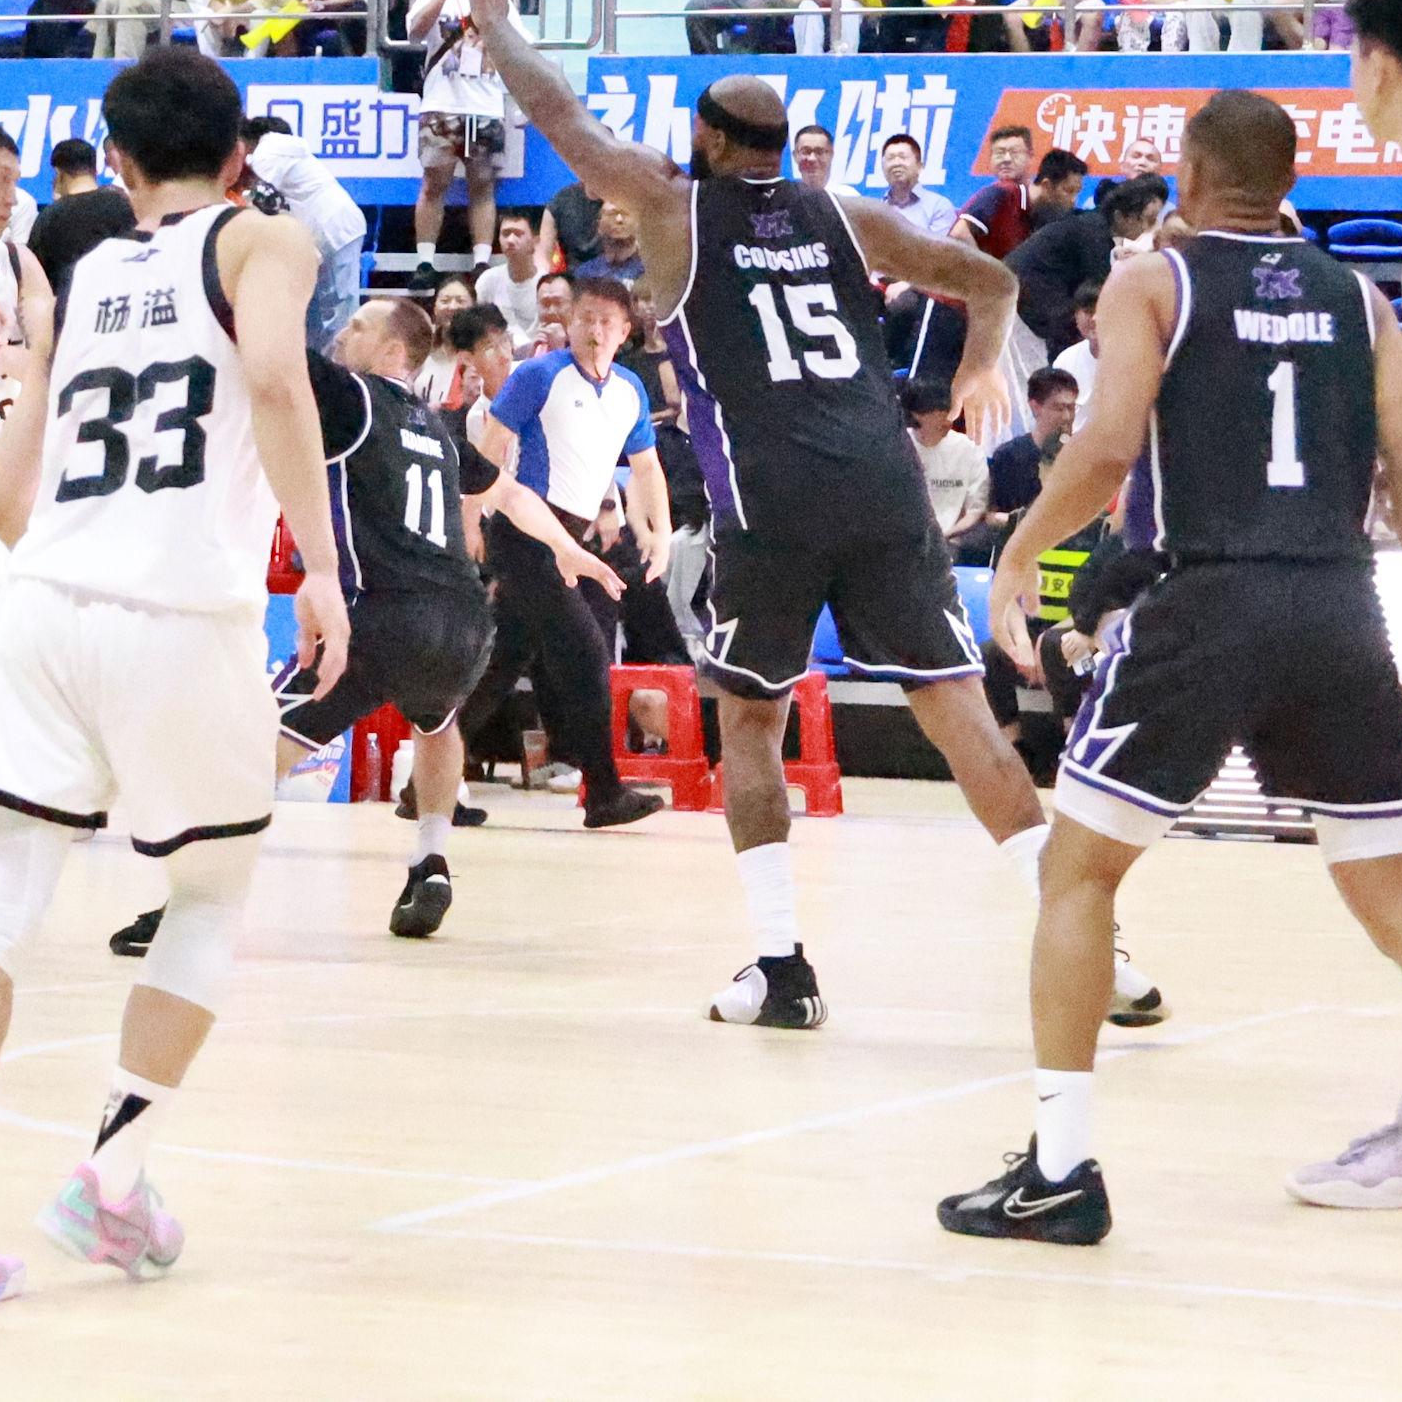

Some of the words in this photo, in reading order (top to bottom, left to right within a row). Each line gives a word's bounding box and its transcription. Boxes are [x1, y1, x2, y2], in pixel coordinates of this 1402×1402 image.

[734, 242, 830, 272] COUSINS
[95, 288, 178, 334] 杨溢
[748, 283, 861, 381] 15
[55, 354, 216, 503] 33
[1267, 361, 1305, 485] 1
[404, 463, 447, 548] 11
